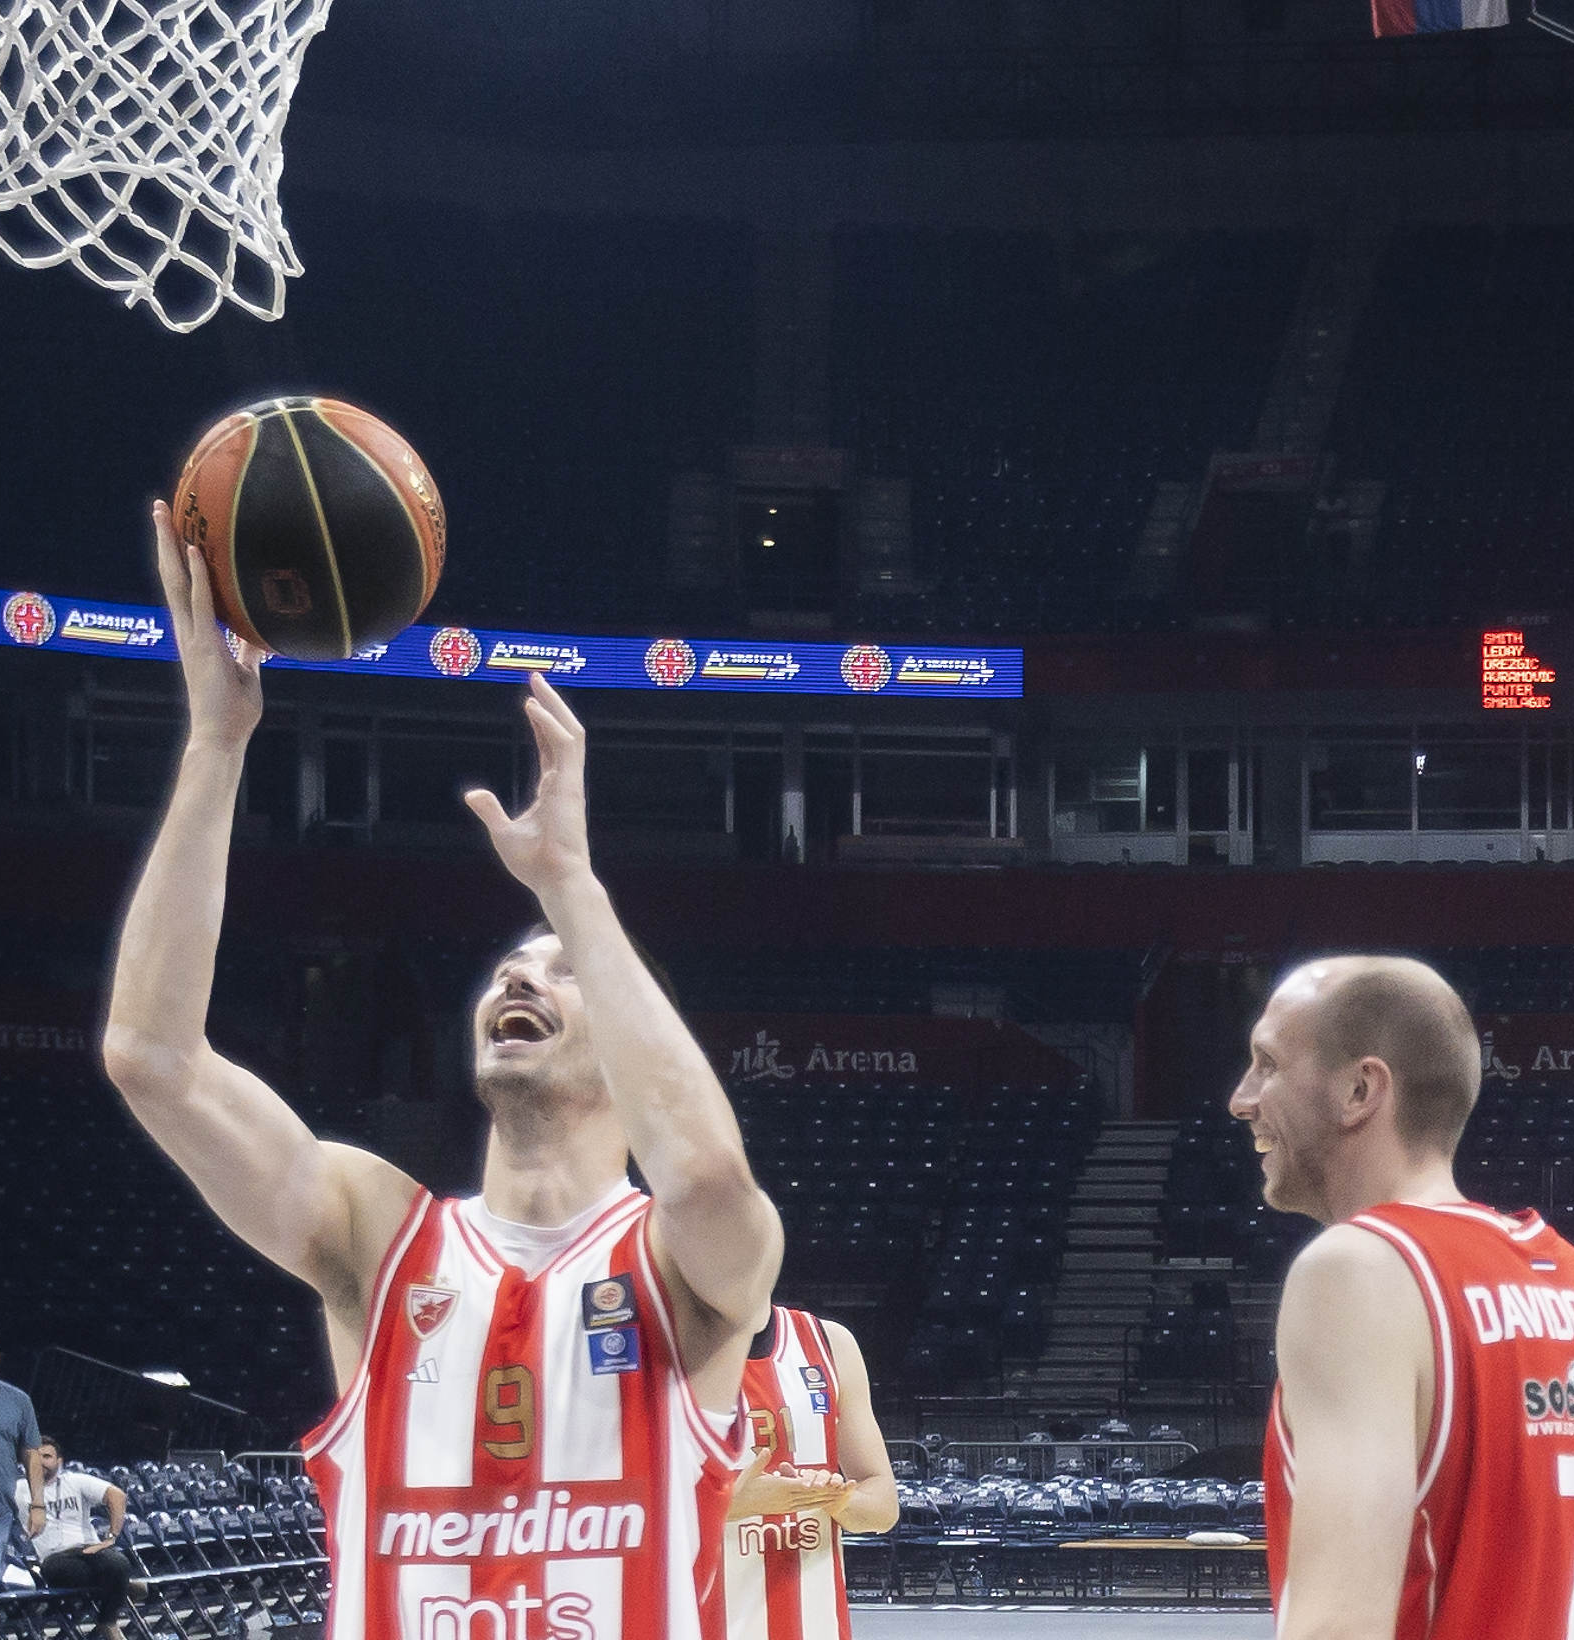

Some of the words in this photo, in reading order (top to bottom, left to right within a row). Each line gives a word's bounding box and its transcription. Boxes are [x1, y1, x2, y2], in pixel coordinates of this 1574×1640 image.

[64, 609, 160, 636] ADMIRAL
[127, 630, 163, 647] BET
[1483, 632, 1523, 645] SMITH
[1483, 645, 1524, 657] LEDAY
[1483, 683, 1534, 696] PUNTER
[805, 1042, 919, 1073] Arena
[482, 1366, 536, 1460] 9
[747, 1406, 795, 1456] 31
[377, 1490, 646, 1559] meridian
[738, 1513, 824, 1557] mts
